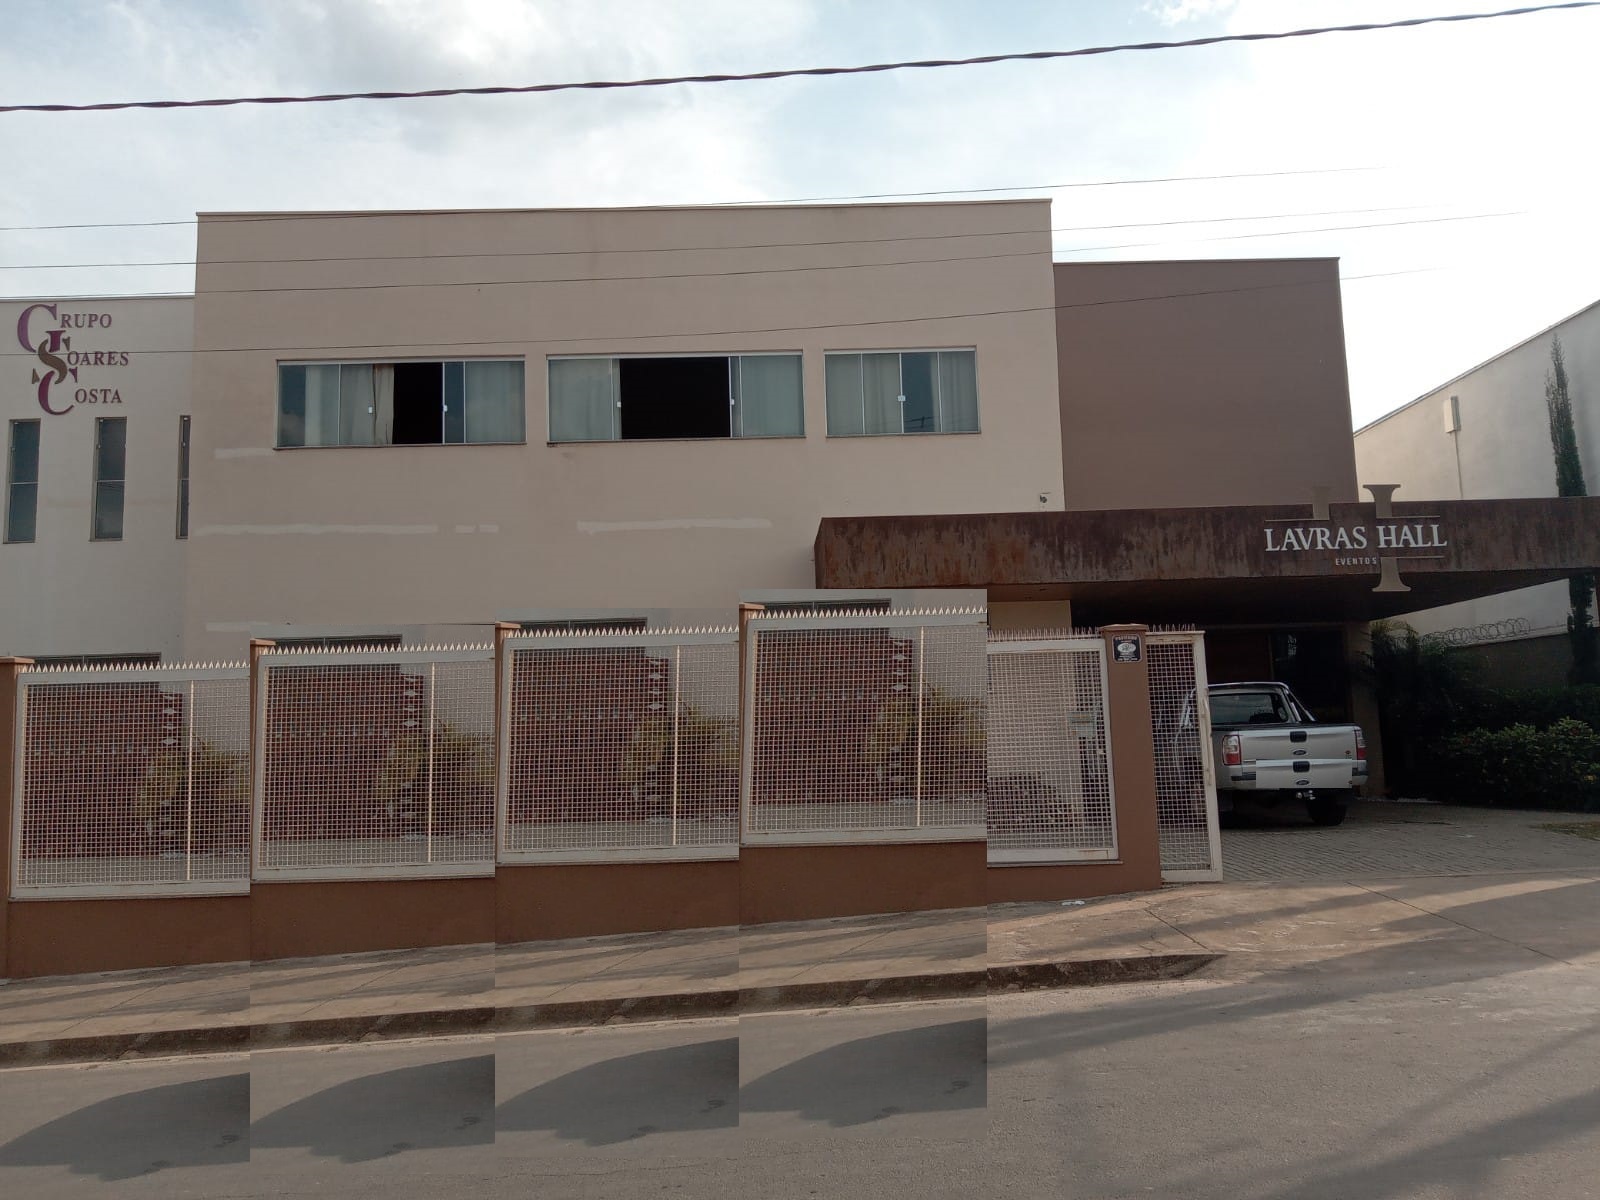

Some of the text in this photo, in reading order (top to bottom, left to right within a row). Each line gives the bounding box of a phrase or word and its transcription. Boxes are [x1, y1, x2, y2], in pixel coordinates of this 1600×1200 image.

[17, 303, 113, 353] GRUPO
[32, 336, 129, 384] SOARES
[38, 367, 122, 415] COSTA
[1264, 524, 1448, 552] LAVRAS HALL
[1334, 556, 1377, 566] EVENTOS
